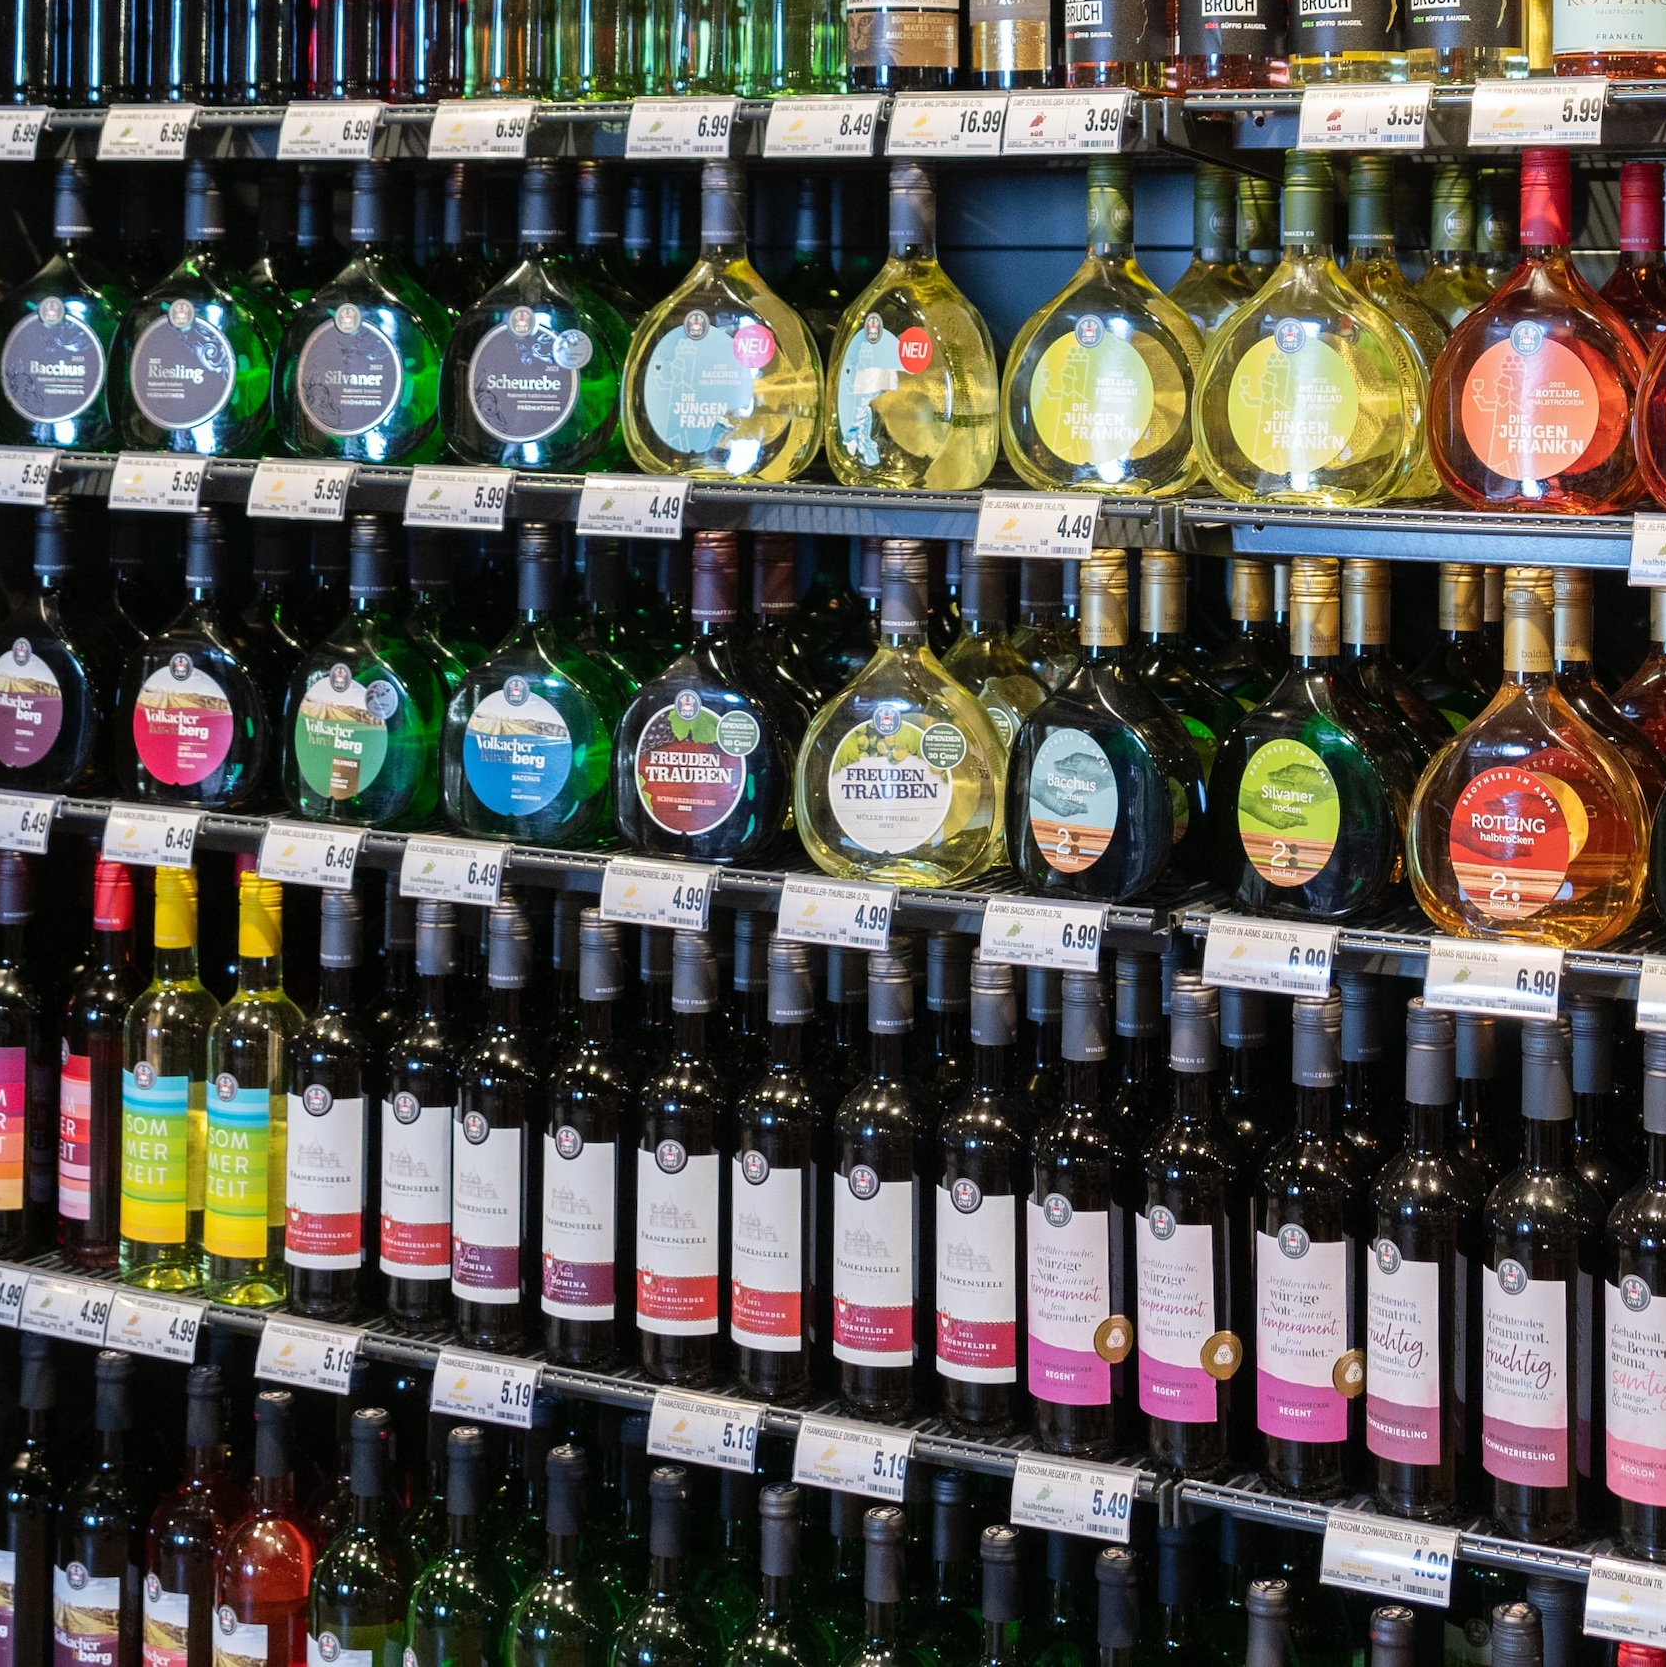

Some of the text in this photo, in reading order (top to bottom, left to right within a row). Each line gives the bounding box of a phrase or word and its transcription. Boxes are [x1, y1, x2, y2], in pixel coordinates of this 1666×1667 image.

[959, 108, 1000, 133] 16.99
[1085, 108, 1120, 132] 3.99
[1386, 104, 1424, 126] 3.99
[1562, 97, 1602, 123] 5.99
[12, 122, 38, 144] 6.99
[160, 121, 187, 143] 6.99
[342, 118, 371, 141] 6.99
[497, 118, 525, 138] 6.99
[697, 114, 729, 138] 6.99
[839, 112, 873, 135] 8.49
[737, 338, 772, 355] NEU
[901, 341, 927, 360] NEU
[29, 361, 85, 375] Bacchus
[148, 363, 204, 383] Riesling
[325, 370, 383, 386] Silvaner
[486, 374, 561, 391] Scheurebe
[21, 463, 48, 486] 5.99
[172, 470, 199, 492] 5.99
[314, 477, 343, 501] 5.99
[474, 484, 504, 509] 5.99
[649, 494, 680, 519] 4.49
[1057, 515, 1091, 537] 4.49
[476, 736, 536, 752] Volkacher
[648, 752, 721, 768] FREUDEN
[645, 767, 733, 784] TRAUBEN
[845, 770, 924, 783] FREUDEN
[1047, 773, 1096, 792] Bacchus
[842, 783, 938, 799] TRAUBEN
[1262, 786, 1314, 803] Silvaner
[1272, 805, 1302, 814] trocken
[21, 810, 47, 833] 6.49
[1471, 813, 1545, 833] ROTLING
[165, 827, 193, 850] 6.49
[1480, 834, 1535, 846] halbtrocken
[325, 845, 355, 870] 6.49
[467, 861, 497, 886] 6.49
[672, 886, 704, 911] 4.99
[855, 905, 888, 930] 4.99
[1062, 923, 1096, 950] 6.99
[80, 1300, 108, 1323] 4.99
[322, 1347, 353, 1374] 5.19
[500, 1381, 531, 1408] 5.19
[1279, 1408, 1311, 1419] REGENT
[722, 1423, 755, 1451] 5.19
[872, 1451, 907, 1479] 5.19
[1022, 1502, 1064, 1514] halbtrocken
[1092, 1489, 1129, 1519] 5.49
